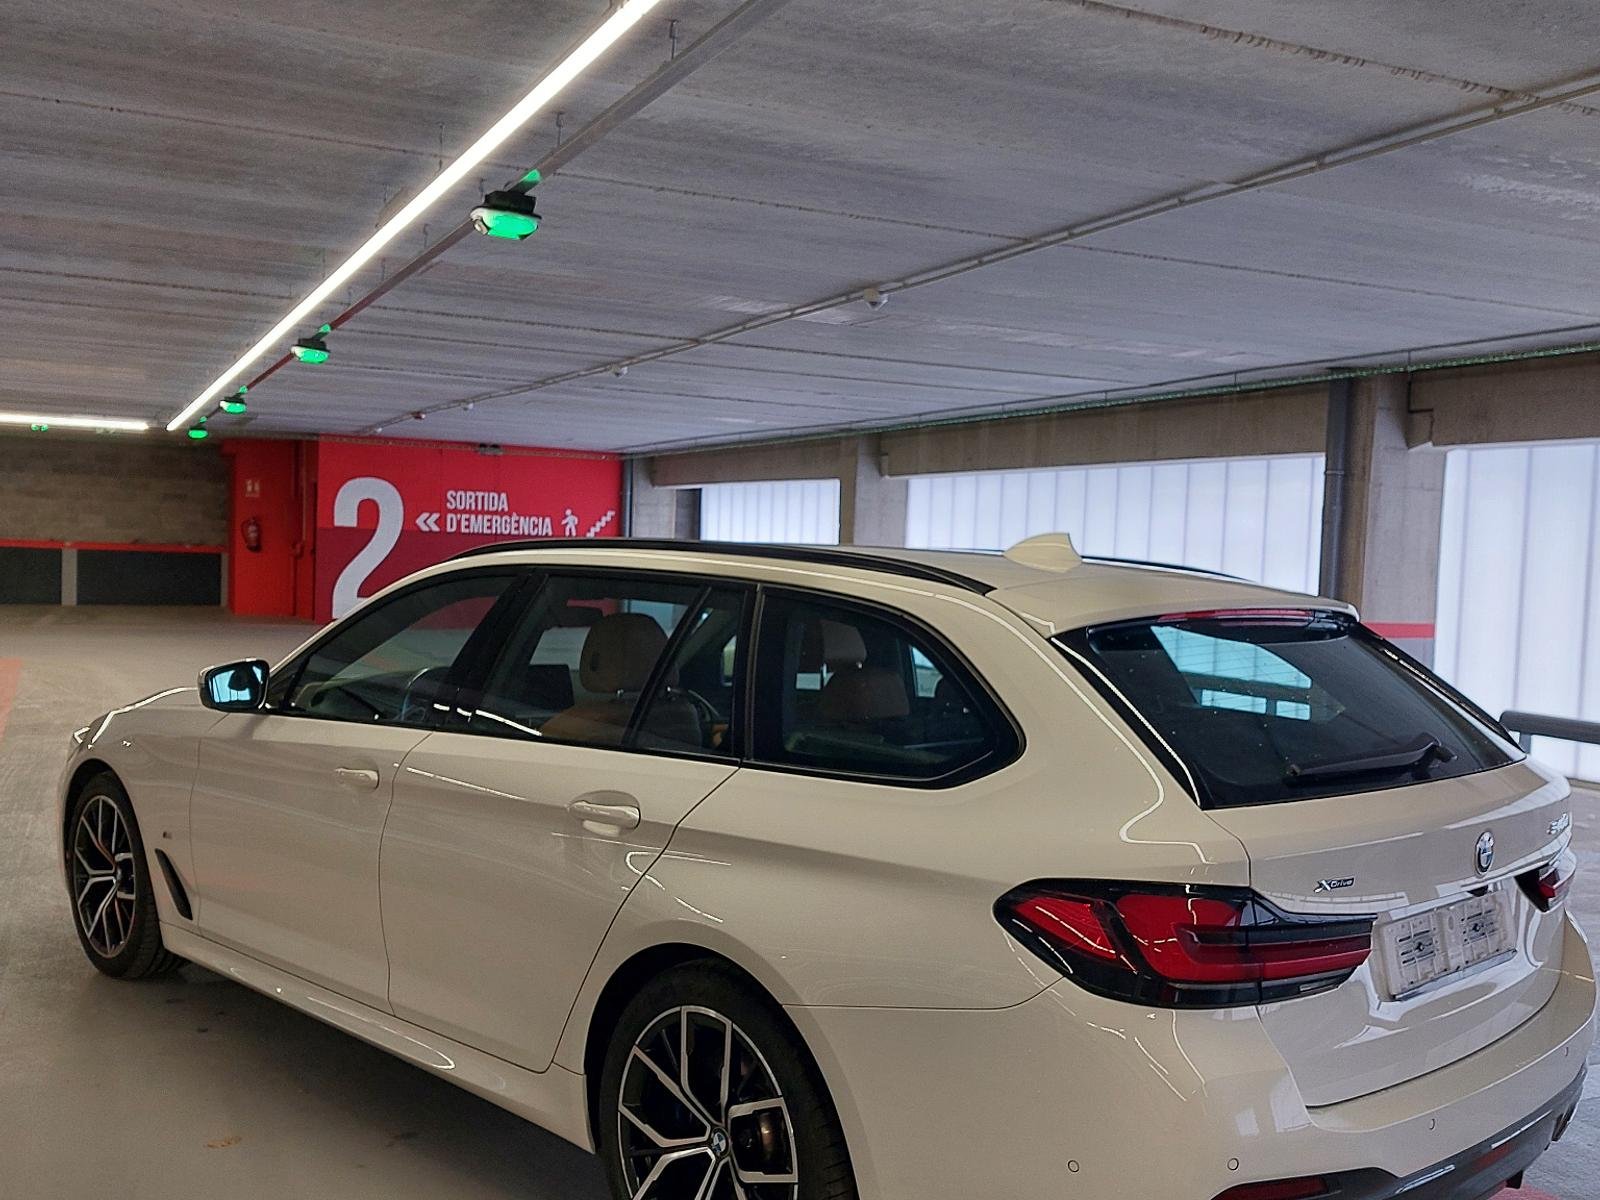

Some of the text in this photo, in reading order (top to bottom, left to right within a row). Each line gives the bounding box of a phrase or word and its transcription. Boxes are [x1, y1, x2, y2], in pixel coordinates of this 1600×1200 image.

[446, 490, 509, 512] SORTIDA
[446, 511, 553, 536] D'EMERGÈNCIA
[333, 476, 404, 620] 2
